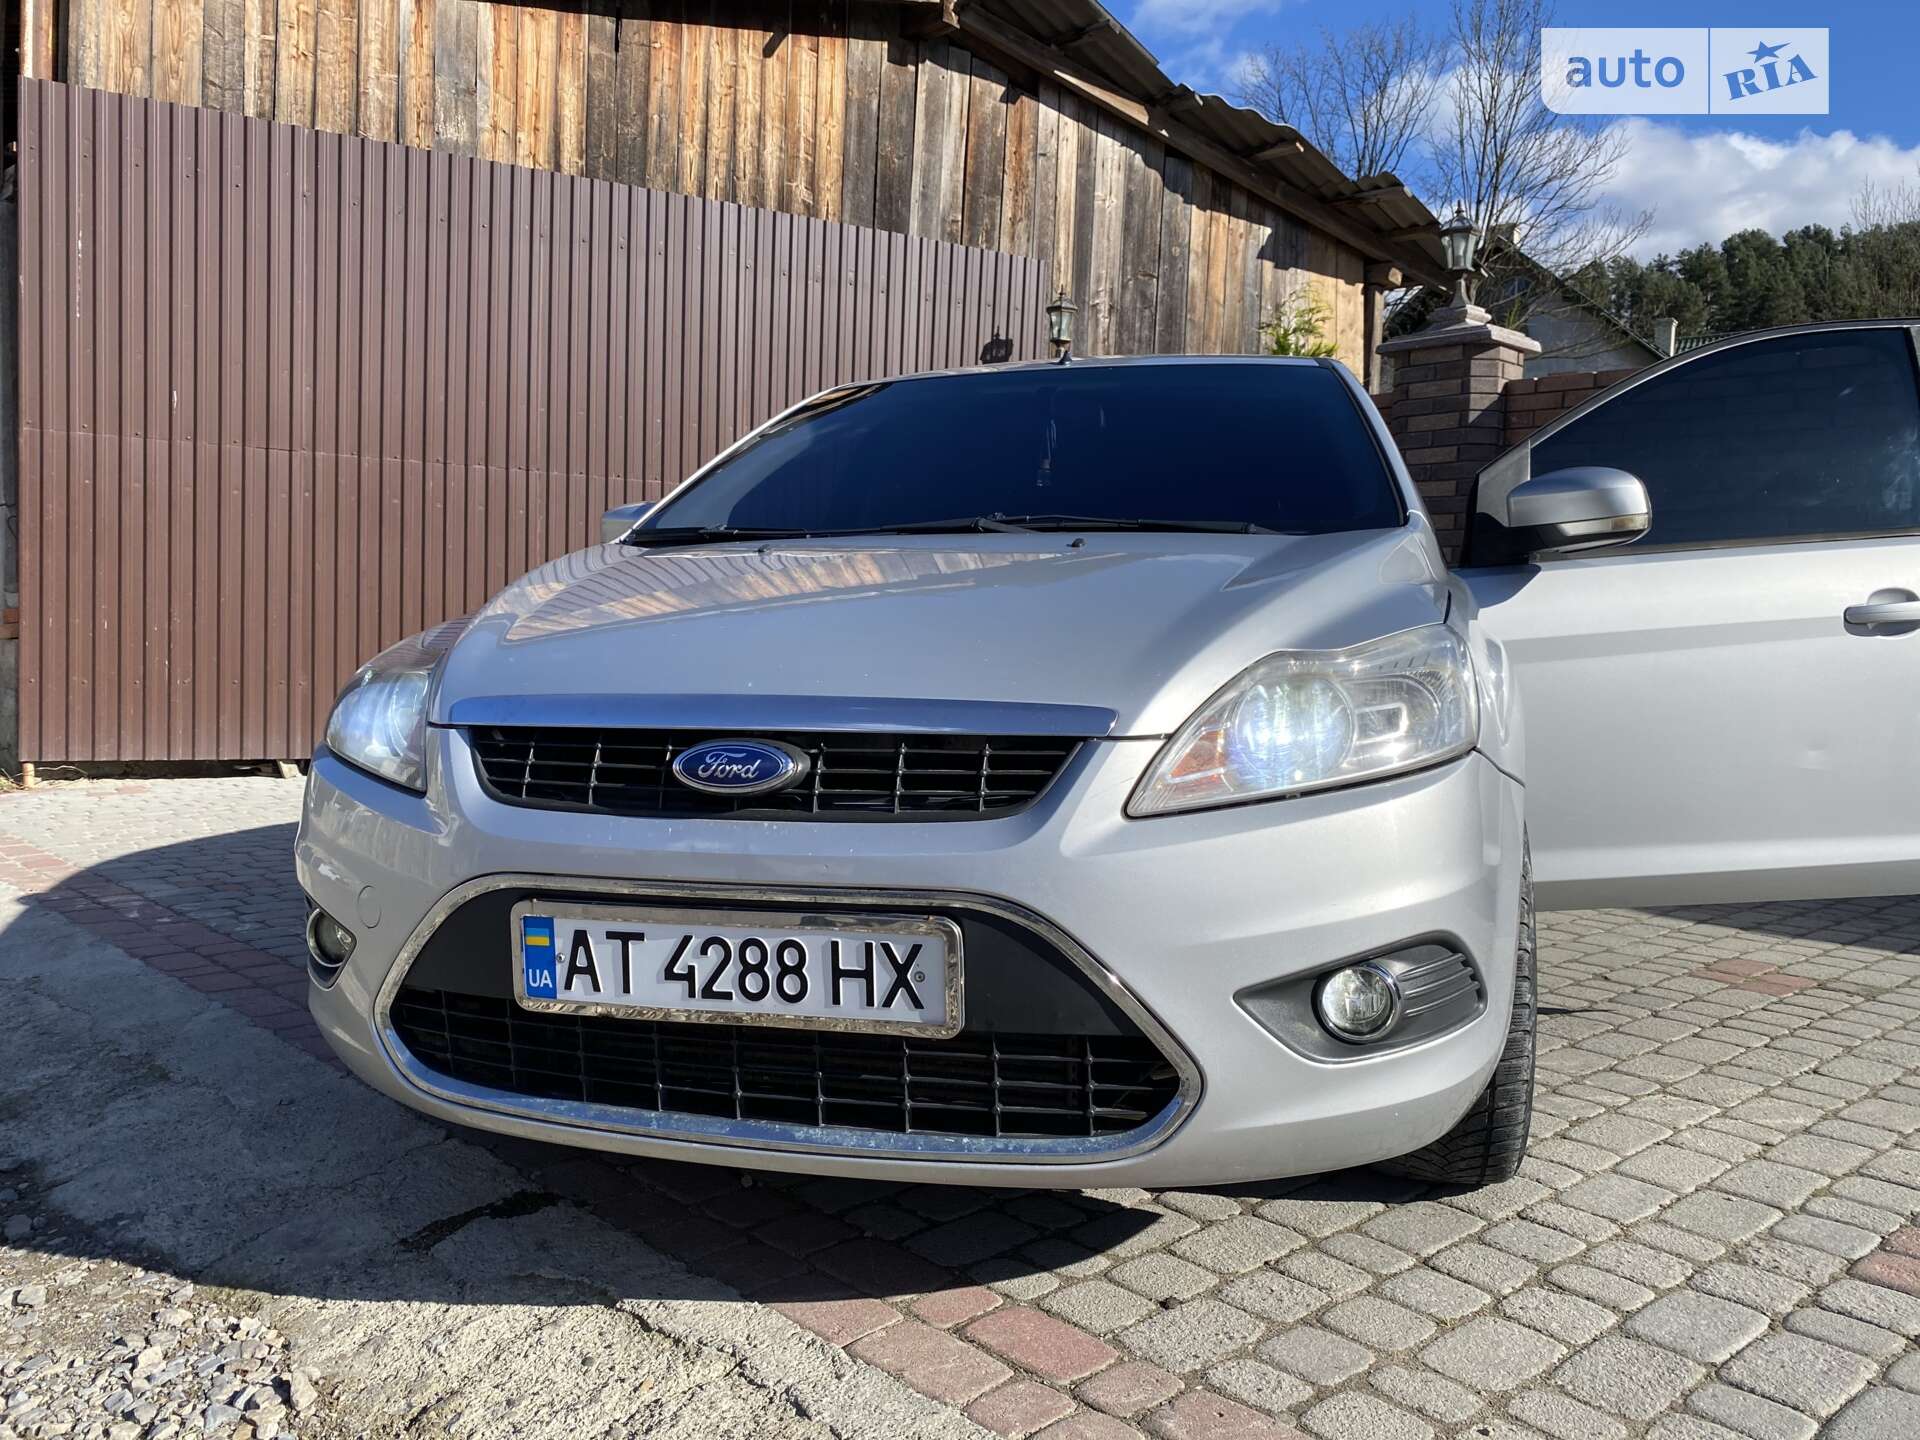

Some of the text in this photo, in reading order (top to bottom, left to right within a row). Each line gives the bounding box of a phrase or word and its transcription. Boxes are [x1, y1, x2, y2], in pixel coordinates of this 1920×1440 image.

[697, 751, 762, 779] Ford
[528, 968, 553, 989] UA
[564, 929, 925, 1010] AT 4288 HX
